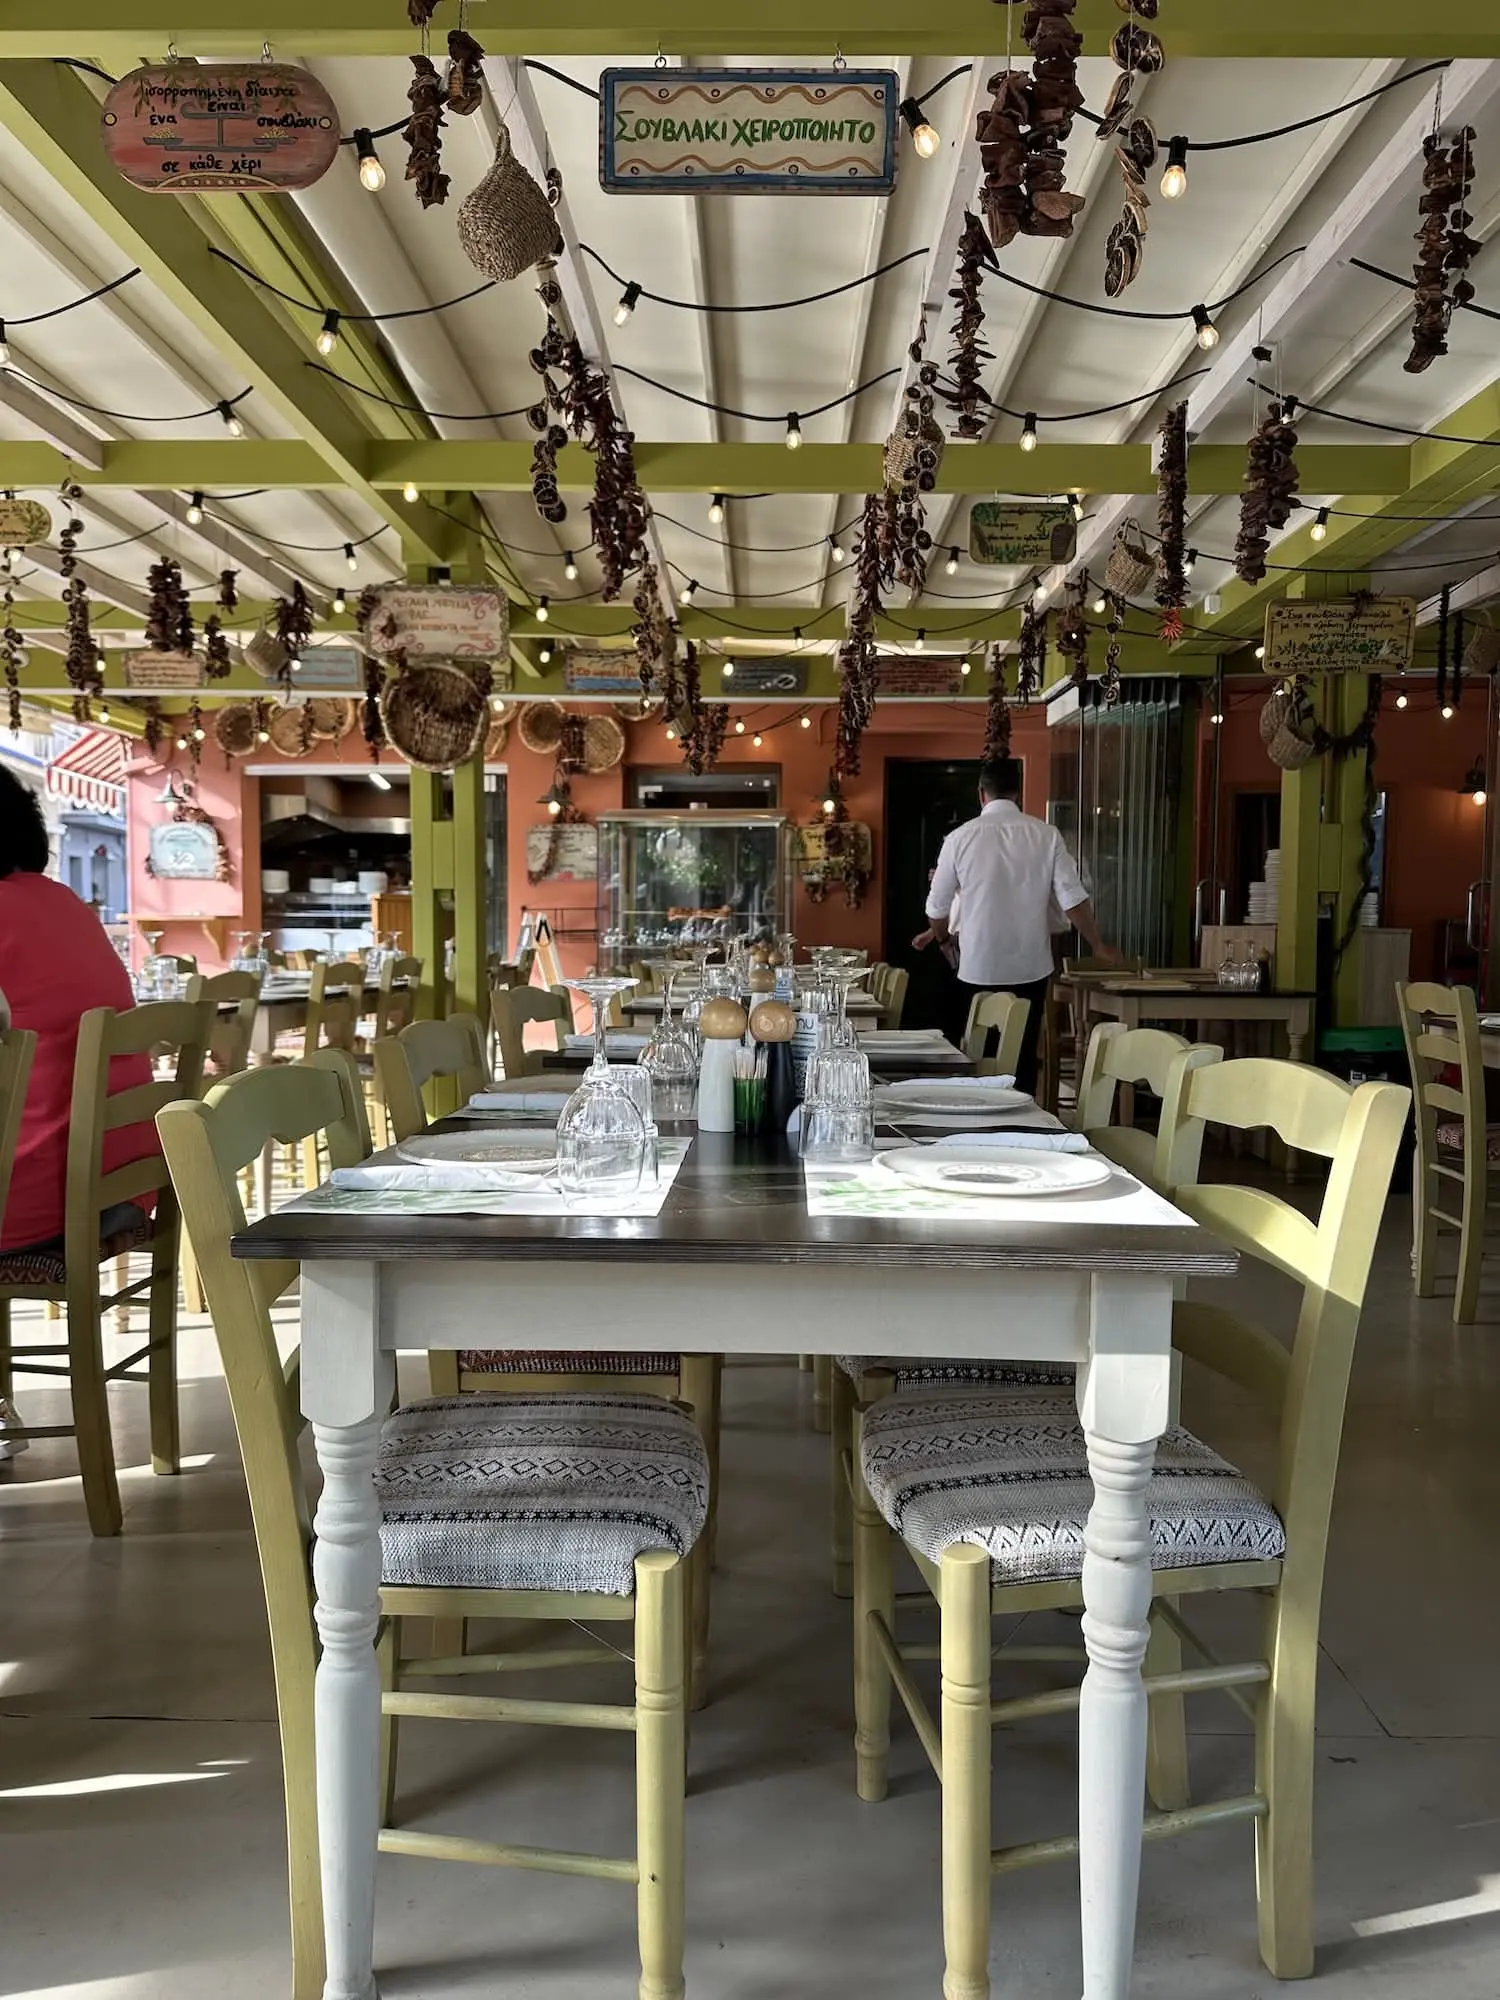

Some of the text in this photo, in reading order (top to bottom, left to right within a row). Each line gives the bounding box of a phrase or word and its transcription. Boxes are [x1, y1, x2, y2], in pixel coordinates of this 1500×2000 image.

[150, 107, 177, 125] ένα
[615, 110, 876, 147] ΣΟΥΒΛΑΚΙ ΧΕΙΡΟΠΟΙΗΤΟ
[161, 153, 262, 175] σε κάθε χέρι
